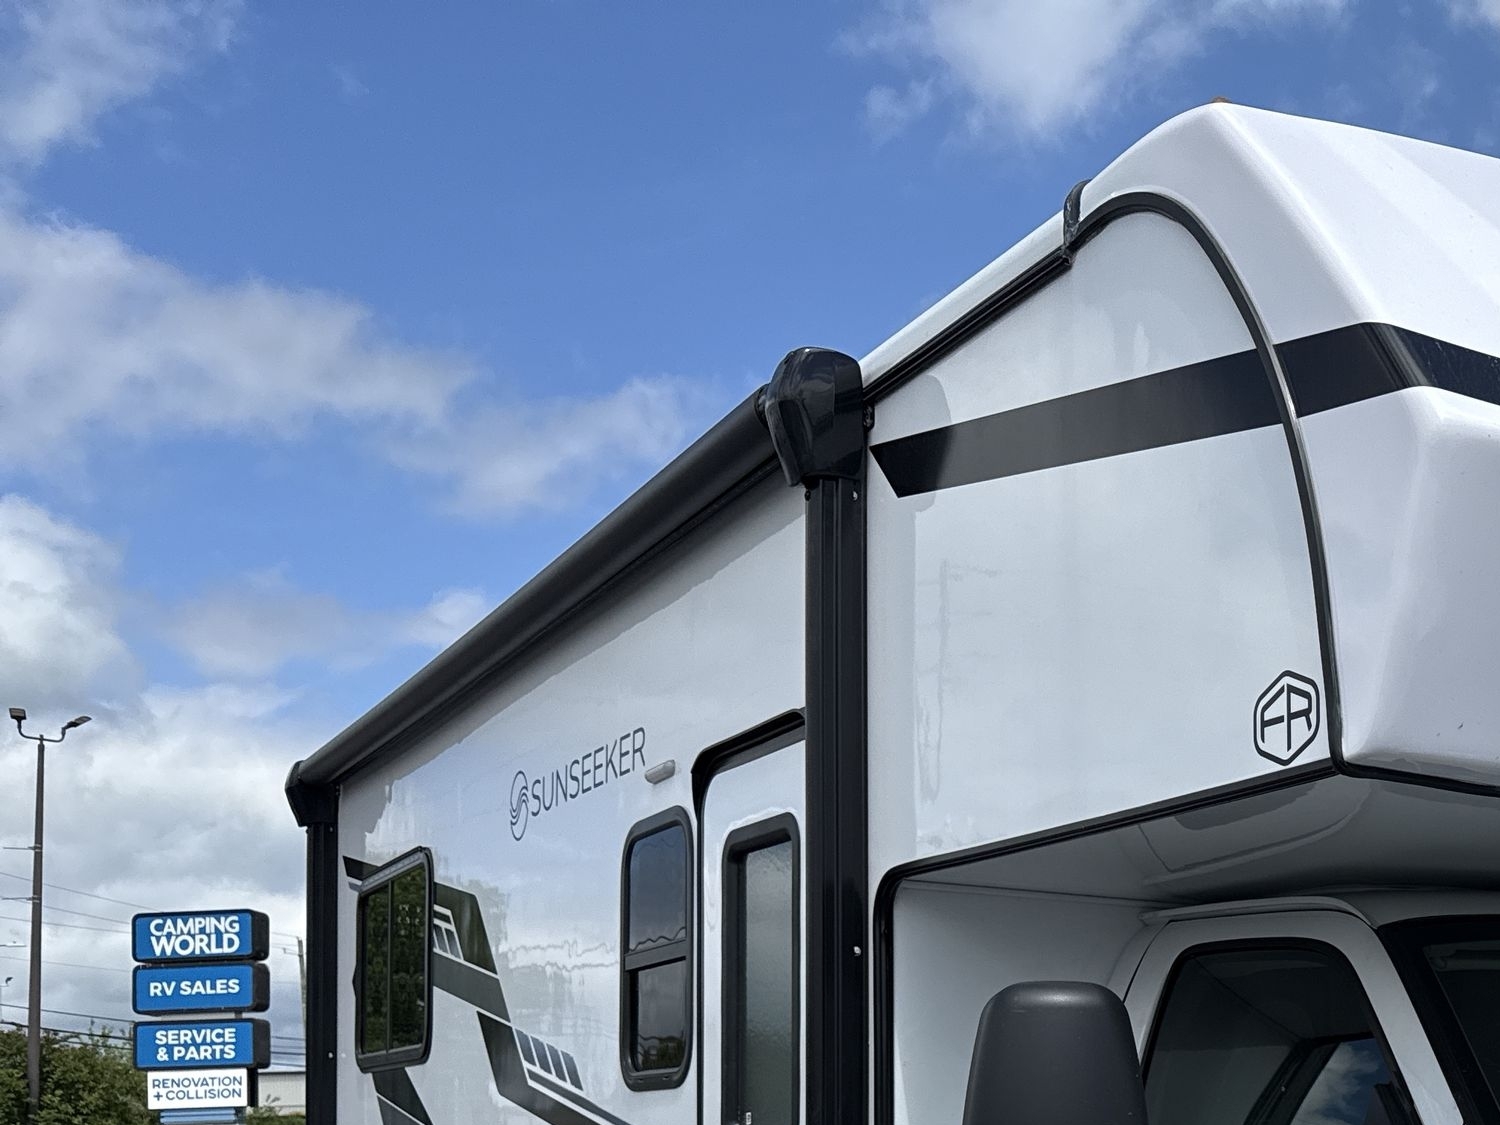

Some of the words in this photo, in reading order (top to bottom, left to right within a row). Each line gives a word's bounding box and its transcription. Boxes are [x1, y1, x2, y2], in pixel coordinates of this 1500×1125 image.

[531, 727, 646, 817] SUNSEEKER
[149, 915, 240, 937] CAMPING
[150, 933, 240, 957] WORLD
[149, 981, 177, 997] RV
[179, 978, 240, 996] SALES
[154, 1028, 237, 1045] SERVICE
[156, 1046, 170, 1062] &
[173, 1044, 236, 1061] PARTS
[152, 1075, 243, 1090] RENOVATION
